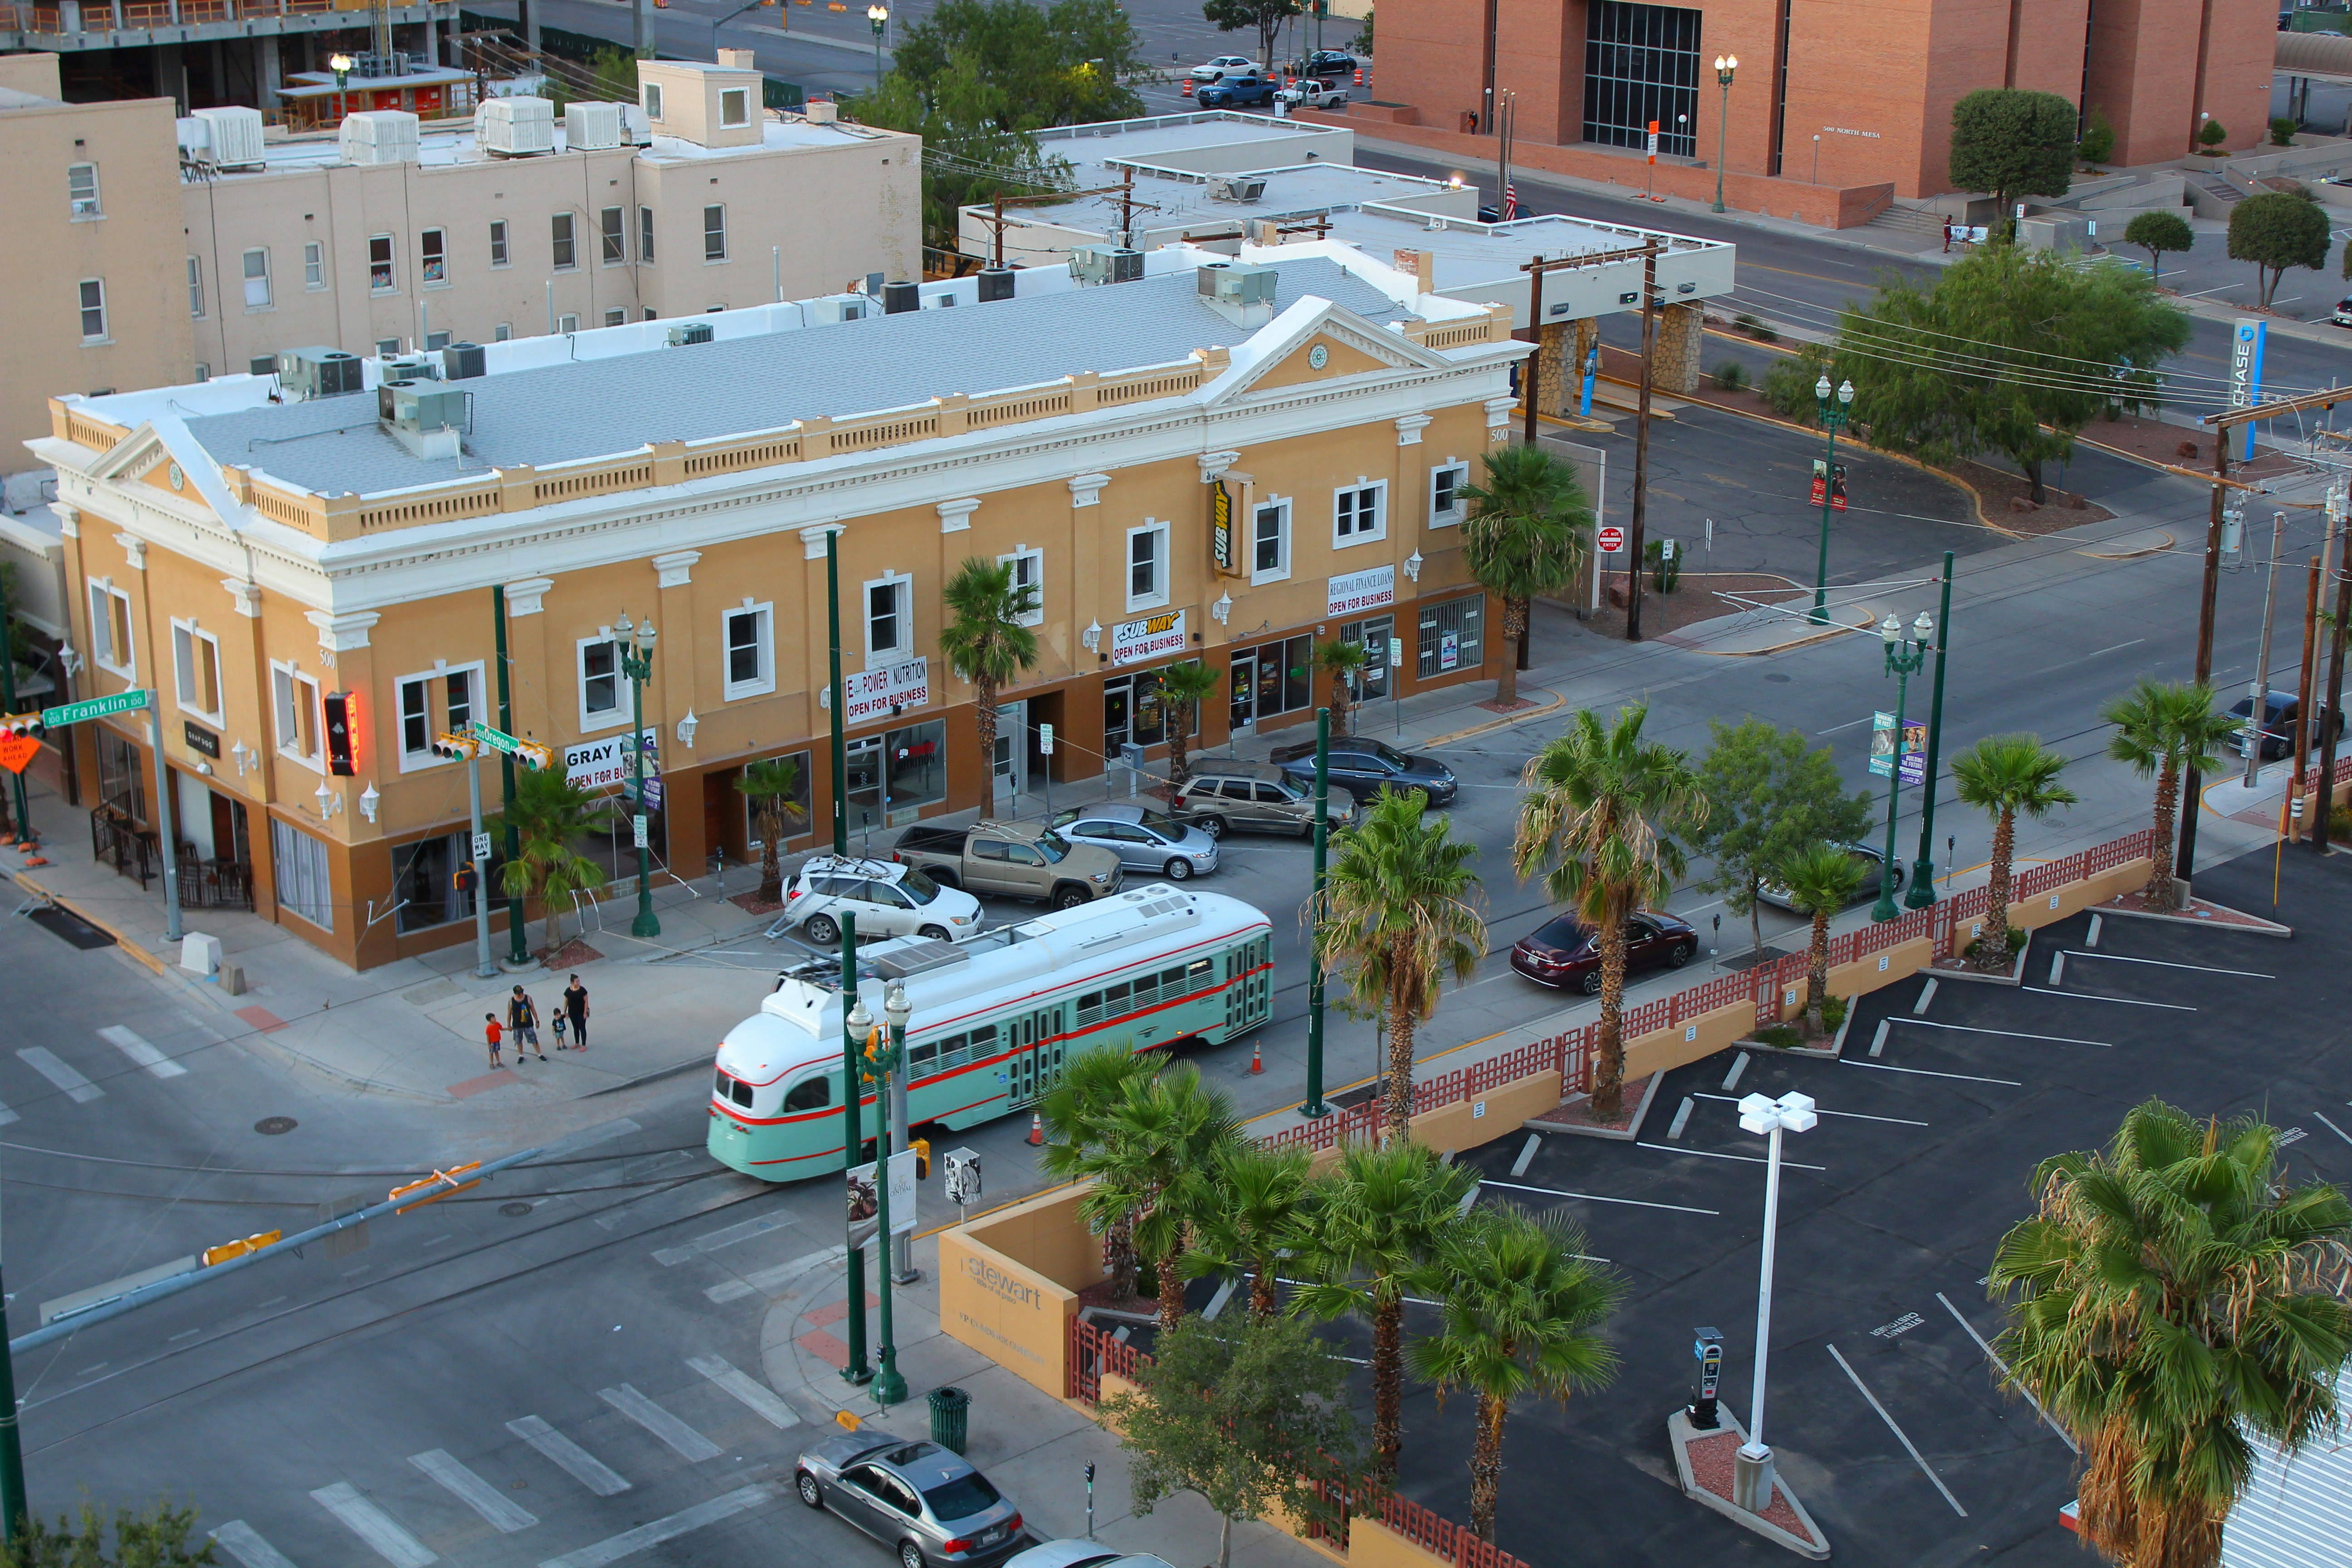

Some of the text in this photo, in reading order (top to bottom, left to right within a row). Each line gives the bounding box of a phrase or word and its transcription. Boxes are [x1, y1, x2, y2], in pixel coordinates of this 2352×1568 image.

[2233, 344, 2250, 407] CHASE
[1491, 428, 1508, 442] 500
[1214, 481, 1229, 568] SUBWAY
[1329, 571, 1393, 596] REGIONAL FINANCE LOANS
[1329, 590, 1392, 613] OPEN FOR BUSINESS
[1465, 610, 1478, 618] LOANS
[1117, 611, 1181, 643] SUBWAY
[1114, 633, 1183, 660] OPEN FOR BUSINESS
[1421, 650, 1433, 658] LOANS
[319, 651, 336, 669] 500
[893, 660, 926, 686] NUTRITION
[49, 715, 60, 724] 100
[63, 698, 127, 721] Franklin
[131, 696, 142, 706] 100
[849, 686, 926, 717] OPEN FOR BUSINESS
[2, 744, 23, 753] WORK
[476, 728, 484, 739] 500
[484, 728, 510, 751] Oregon
[3, 753, 27, 762] AHEAD
[567, 744, 612, 766] GRAY
[895, 753, 935, 772] NUTRITION
[1908, 761, 1923, 769] FUTURE
[595, 769, 612, 784] FOR
[474, 835, 488, 843] ONE
[475, 842, 488, 851] WAY
[2278, 1131, 2309, 1148] STEWAR
[969, 1258, 1041, 1311] stewart
[977, 1278, 987, 1289] title
[1001, 1292, 1016, 1304] paso
[1869, 1312, 1919, 1336] CUSTOMER
[1883, 1317, 1925, 1339] STEWART
